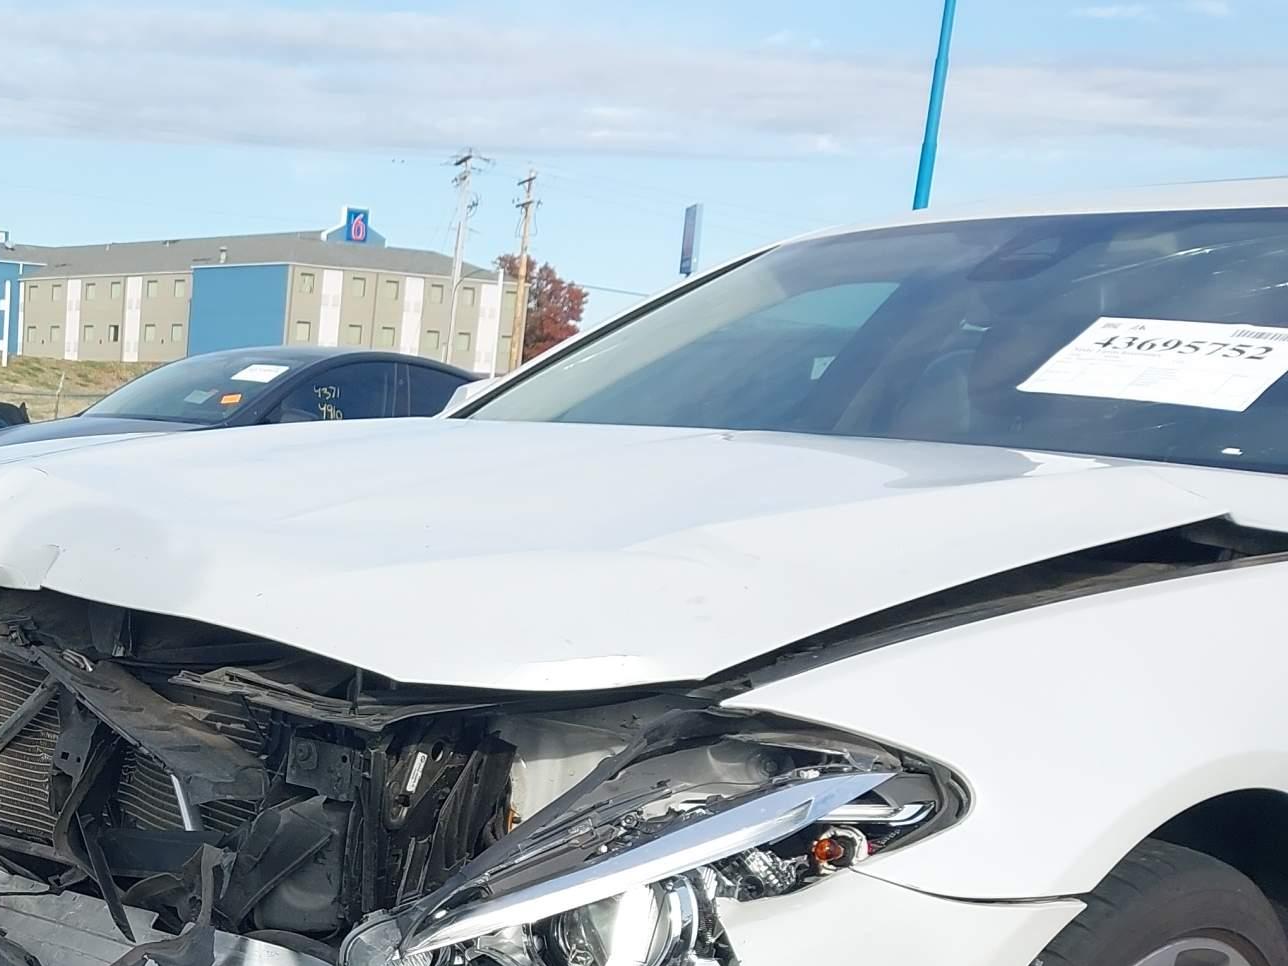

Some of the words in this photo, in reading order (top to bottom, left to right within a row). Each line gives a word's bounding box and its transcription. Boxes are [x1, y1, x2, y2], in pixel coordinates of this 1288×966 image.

[352, 213, 366, 241] 6
[1094, 335, 1274, 360] 43695752
[313, 385, 340, 400] 4371
[318, 403, 343, 420] 4910
